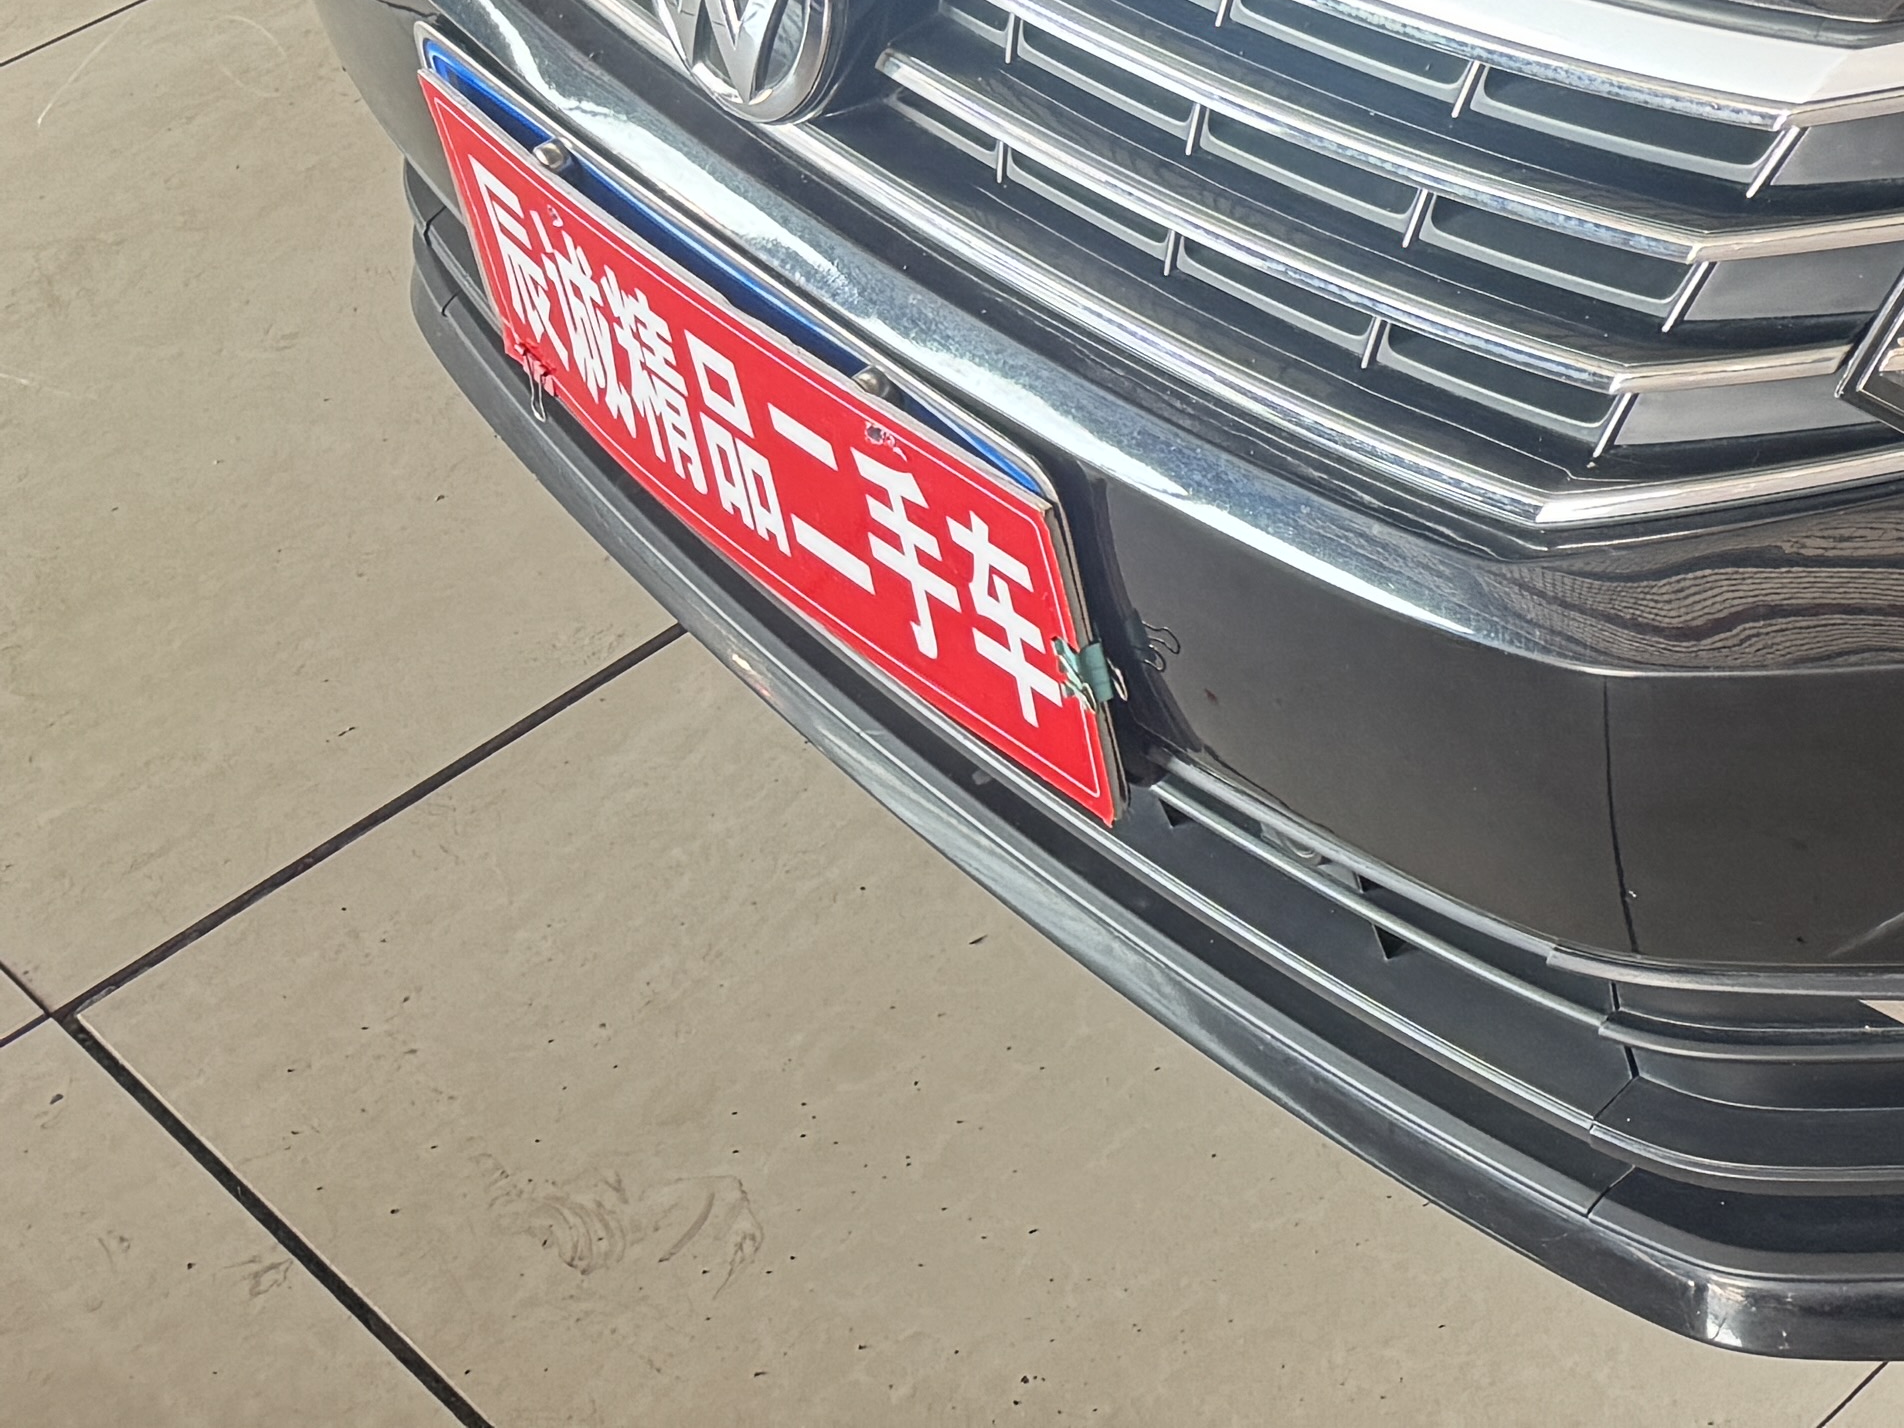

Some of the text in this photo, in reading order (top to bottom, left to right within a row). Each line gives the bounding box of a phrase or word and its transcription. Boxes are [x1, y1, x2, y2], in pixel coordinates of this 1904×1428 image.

[470, 154, 1063, 728] 辰诚精品二手车
